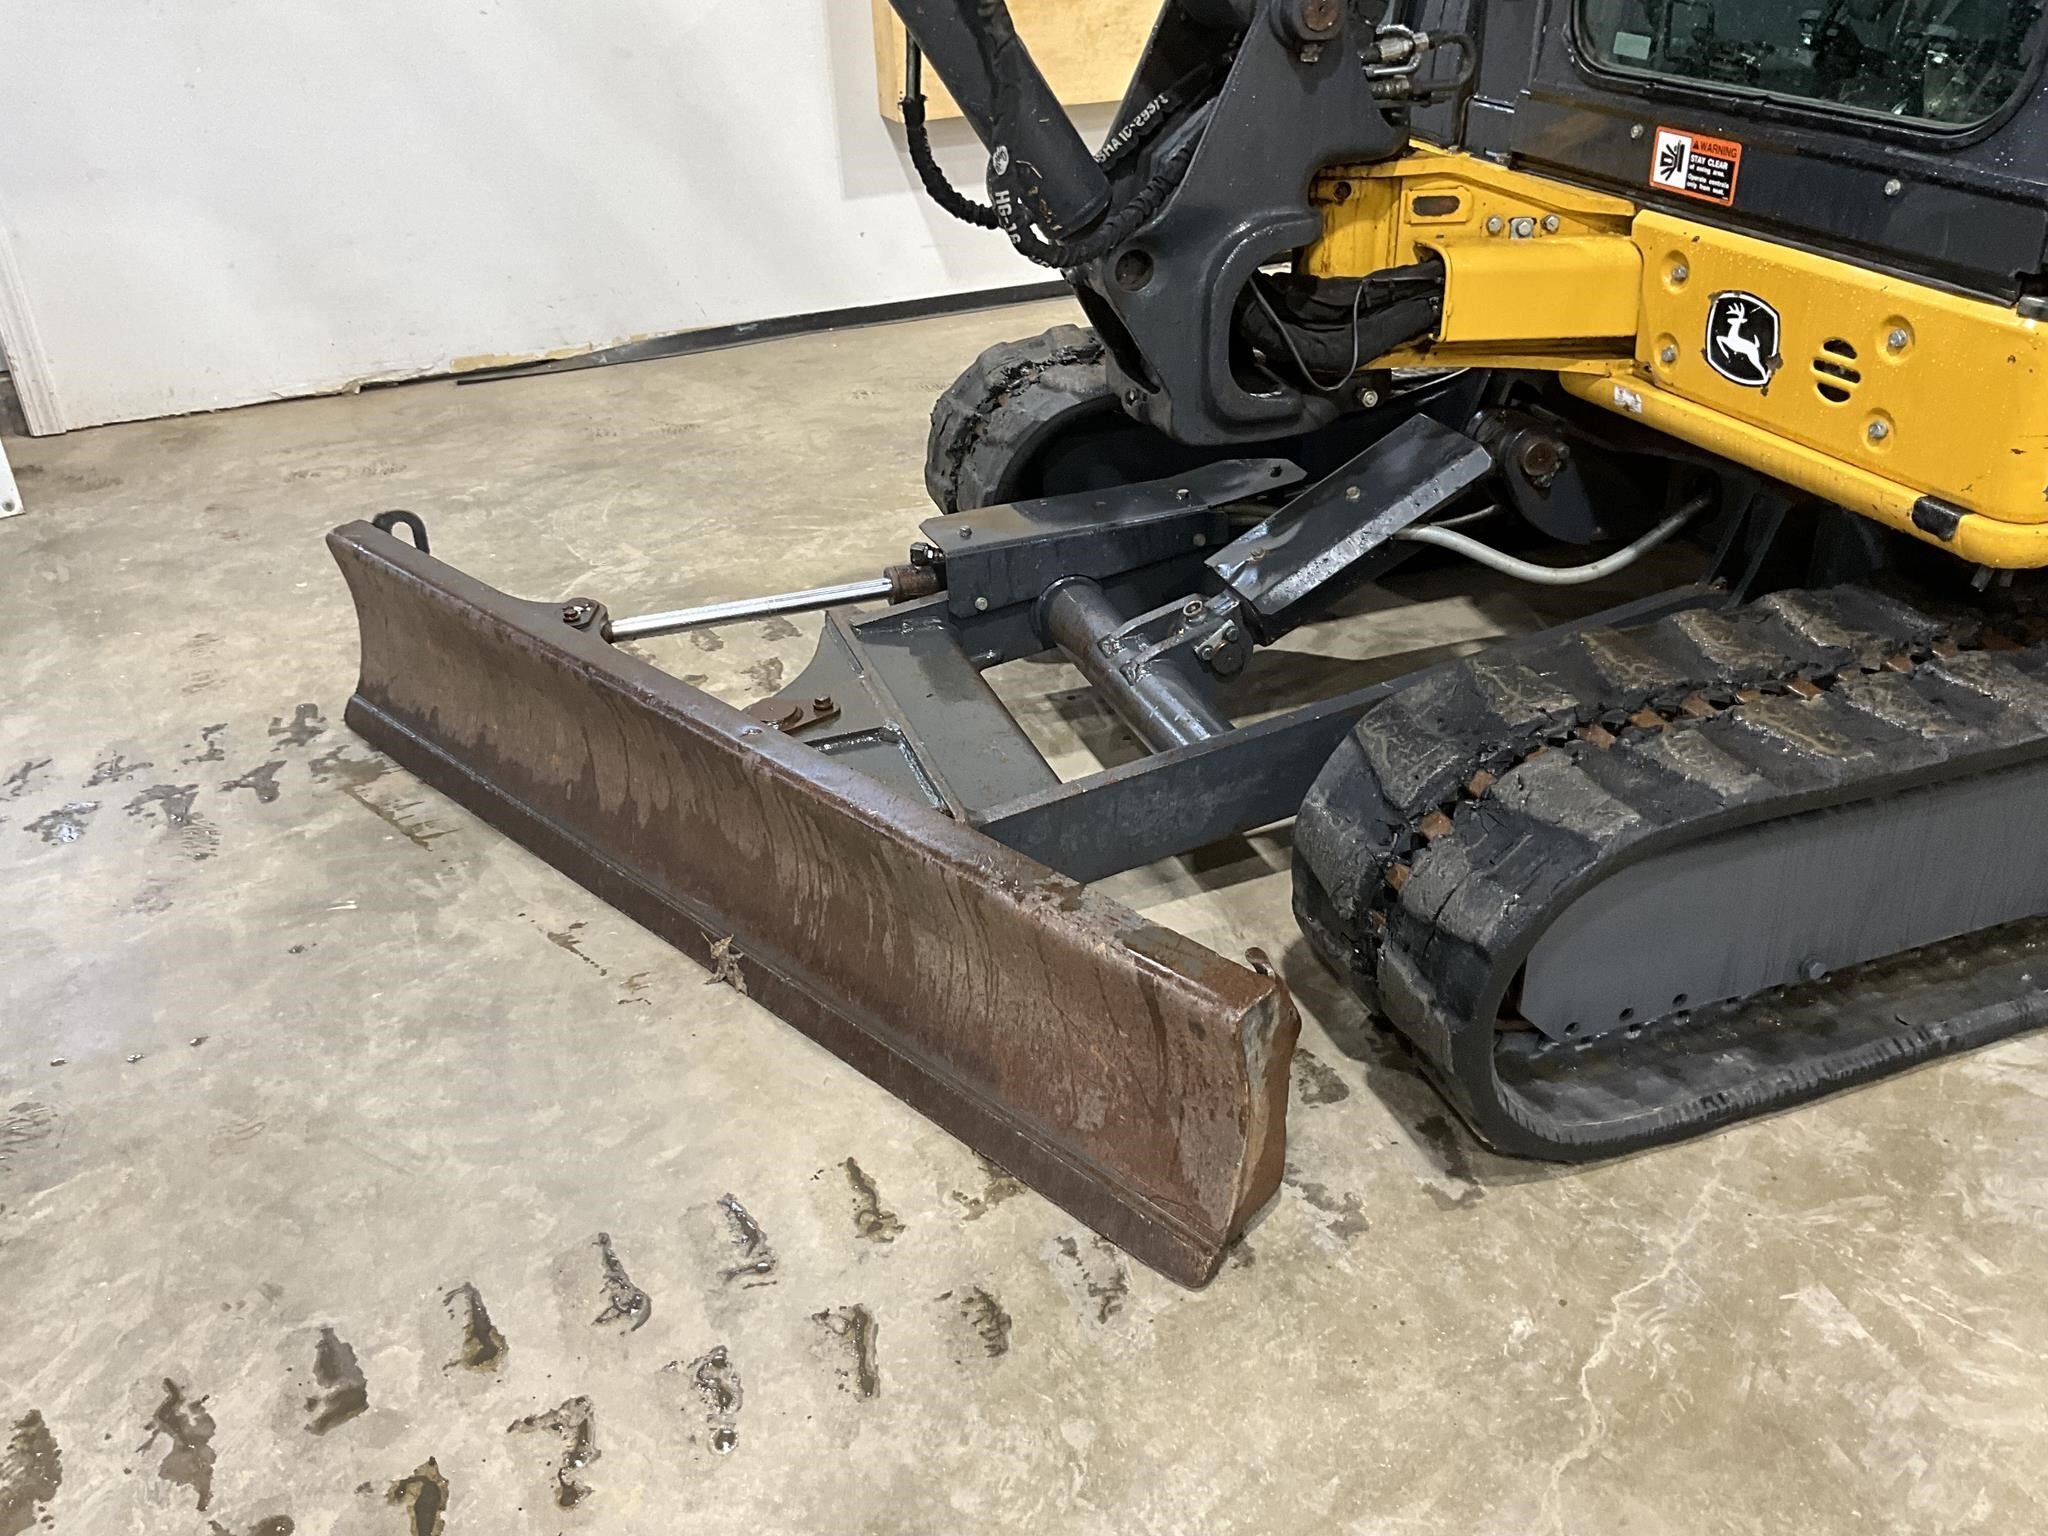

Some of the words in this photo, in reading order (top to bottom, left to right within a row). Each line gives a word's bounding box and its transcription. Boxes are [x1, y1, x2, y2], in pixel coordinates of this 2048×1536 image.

[1093, 138, 1122, 163] SHA
[1701, 141, 1737, 158] WARNING
[1690, 154, 1706, 164] STAY
[1707, 158, 1728, 170] CLEAR
